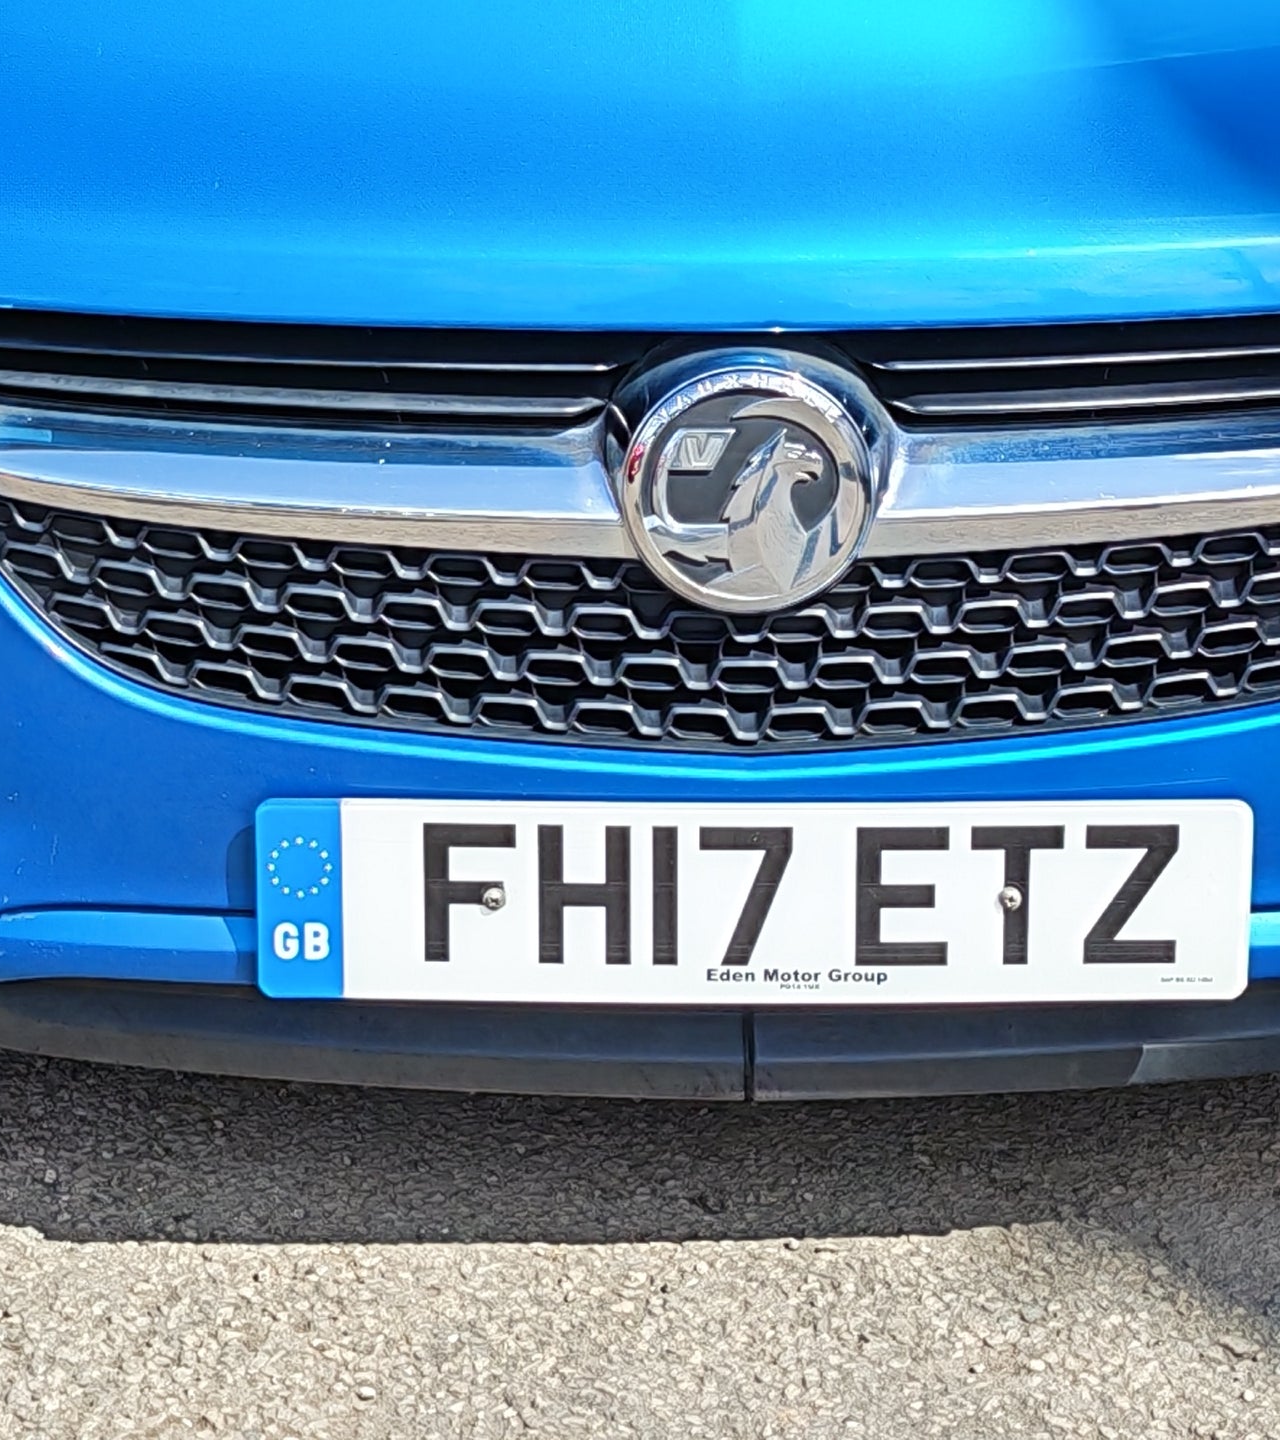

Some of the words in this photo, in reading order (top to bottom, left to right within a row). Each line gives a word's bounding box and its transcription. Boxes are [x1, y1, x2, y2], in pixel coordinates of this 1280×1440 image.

[423, 822, 793, 966] FH17
[854, 823, 1181, 966] ETZ
[273, 921, 331, 961] GB
[706, 968, 756, 982] Eden
[763, 968, 821, 983] Motor
[828, 968, 888, 985] Group
